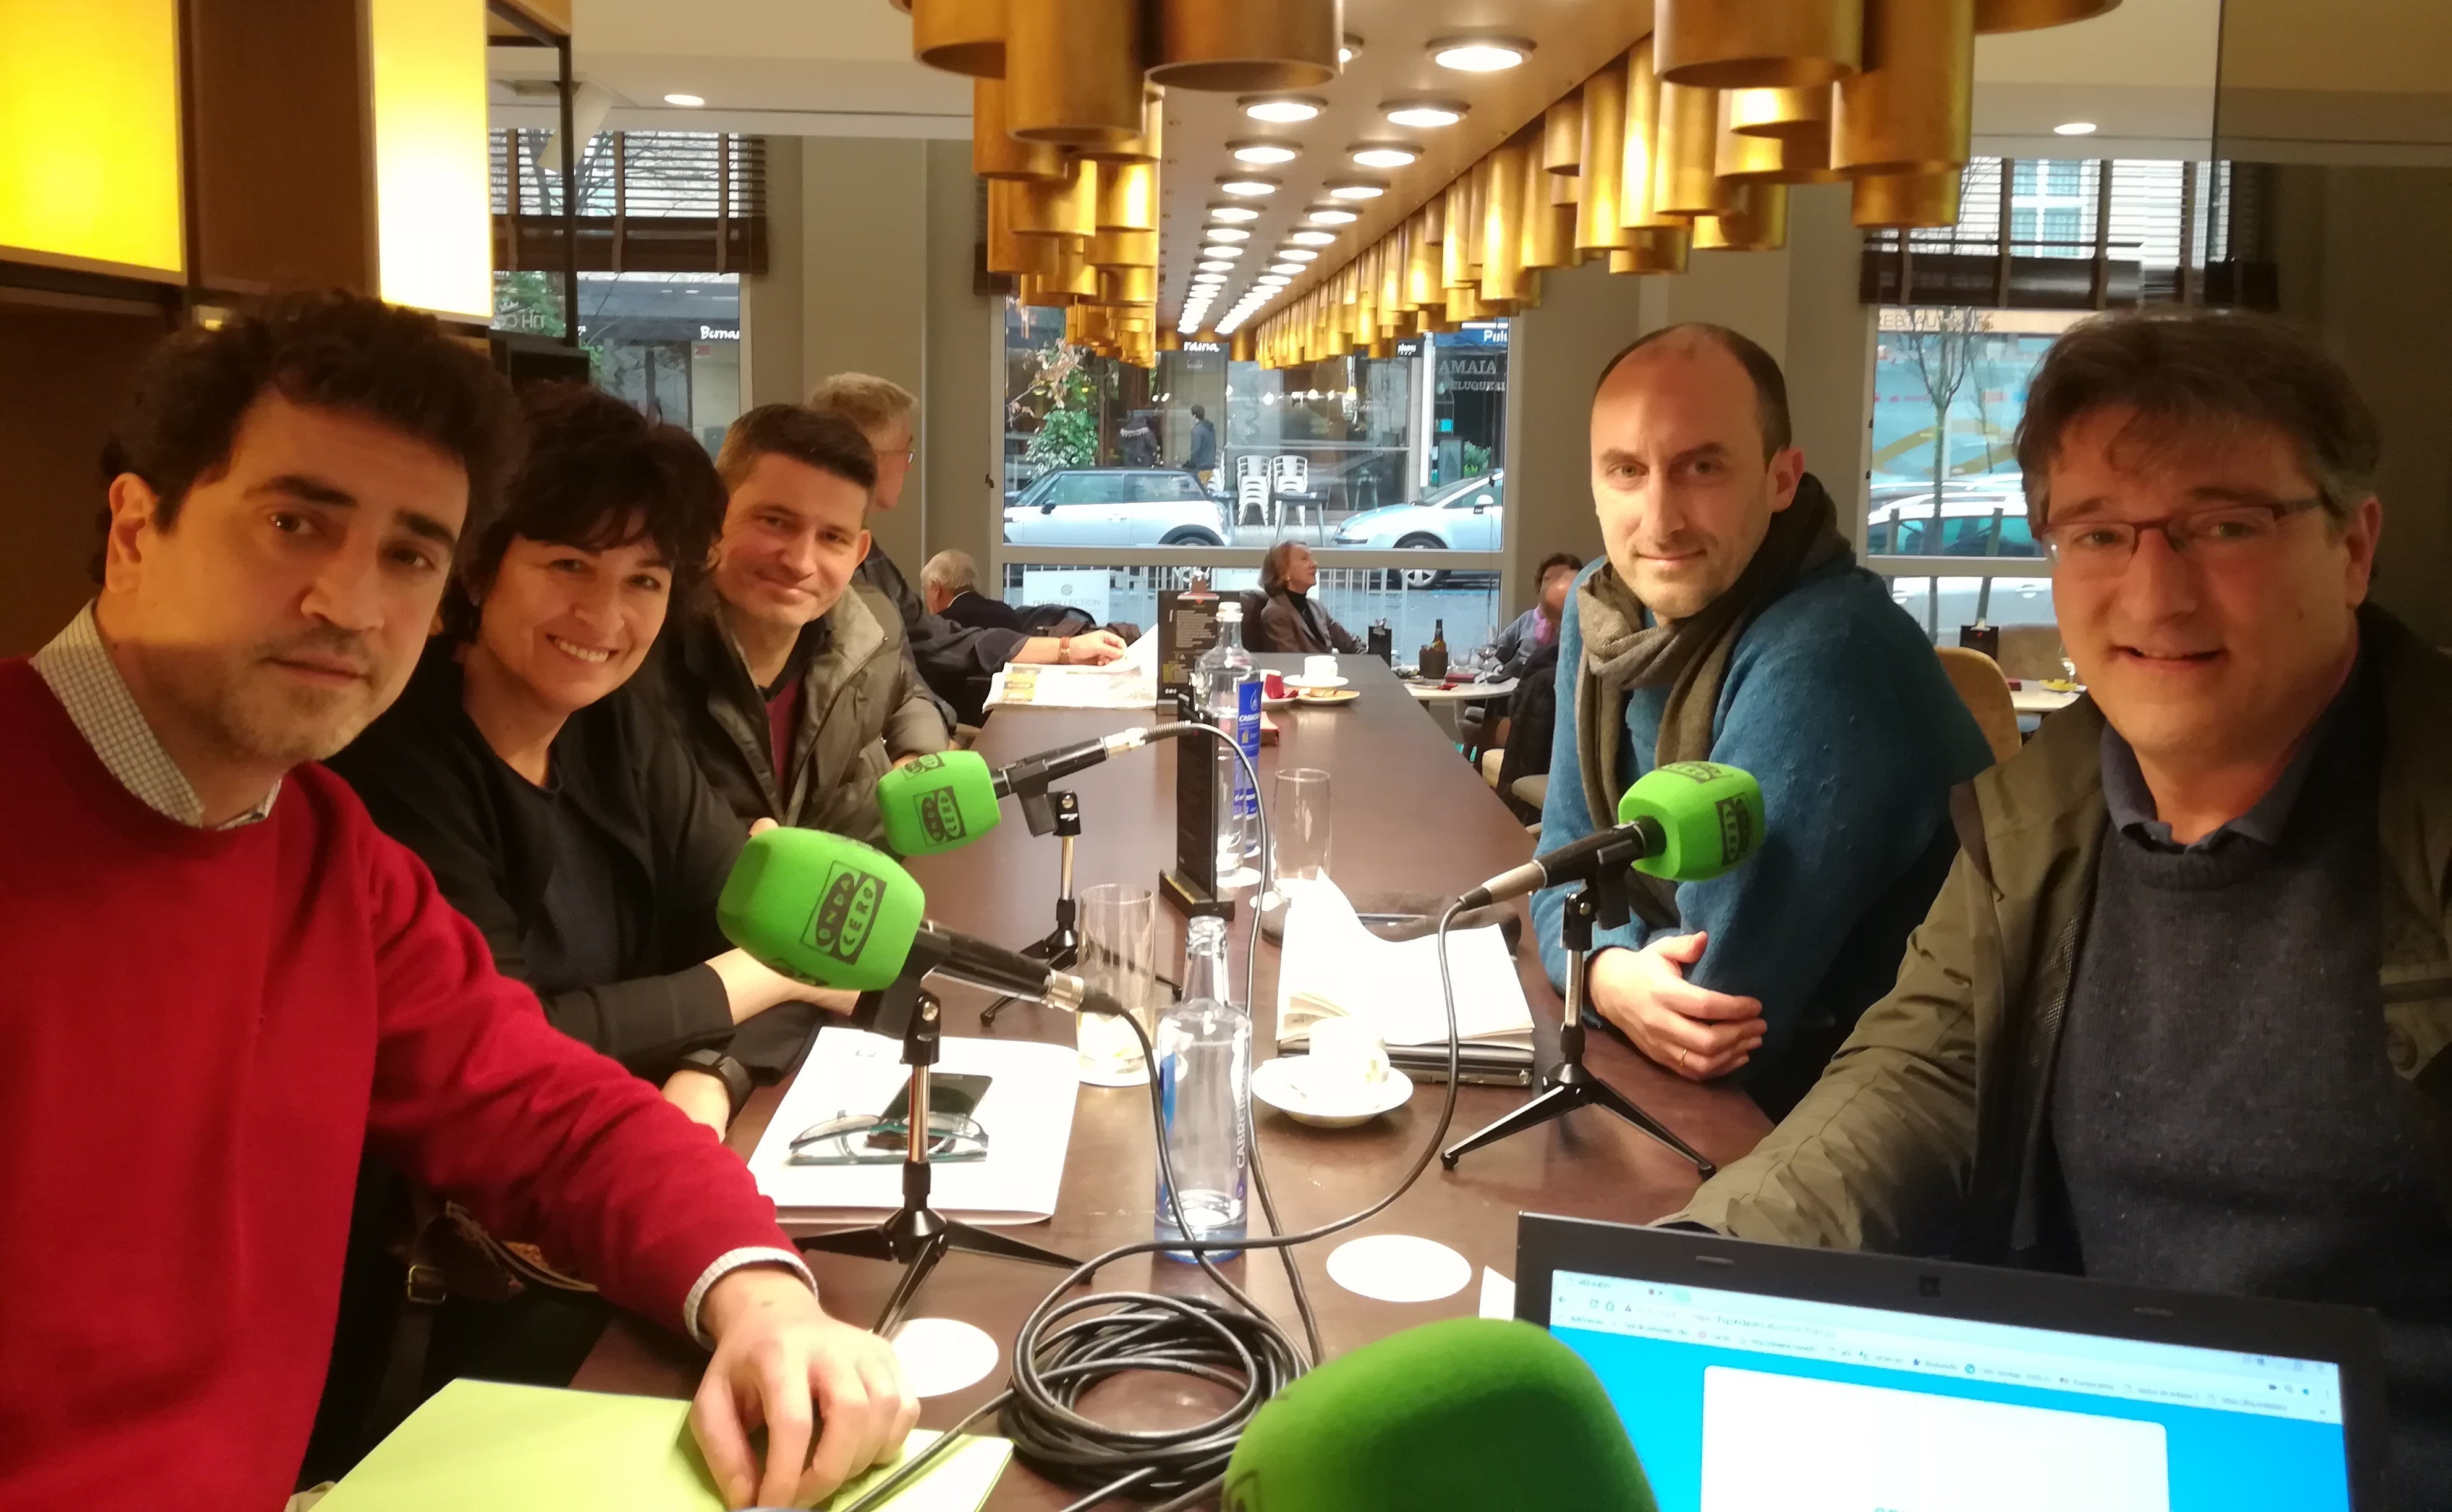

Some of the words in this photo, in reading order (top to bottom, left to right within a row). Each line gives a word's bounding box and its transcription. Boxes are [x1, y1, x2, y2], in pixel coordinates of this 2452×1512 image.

[1438, 360, 1496, 374] AMAIA
[1451, 381, 1506, 391] ELUQUERI
[818, 880, 851, 940] ONDA
[842, 887, 873, 945] CERO
